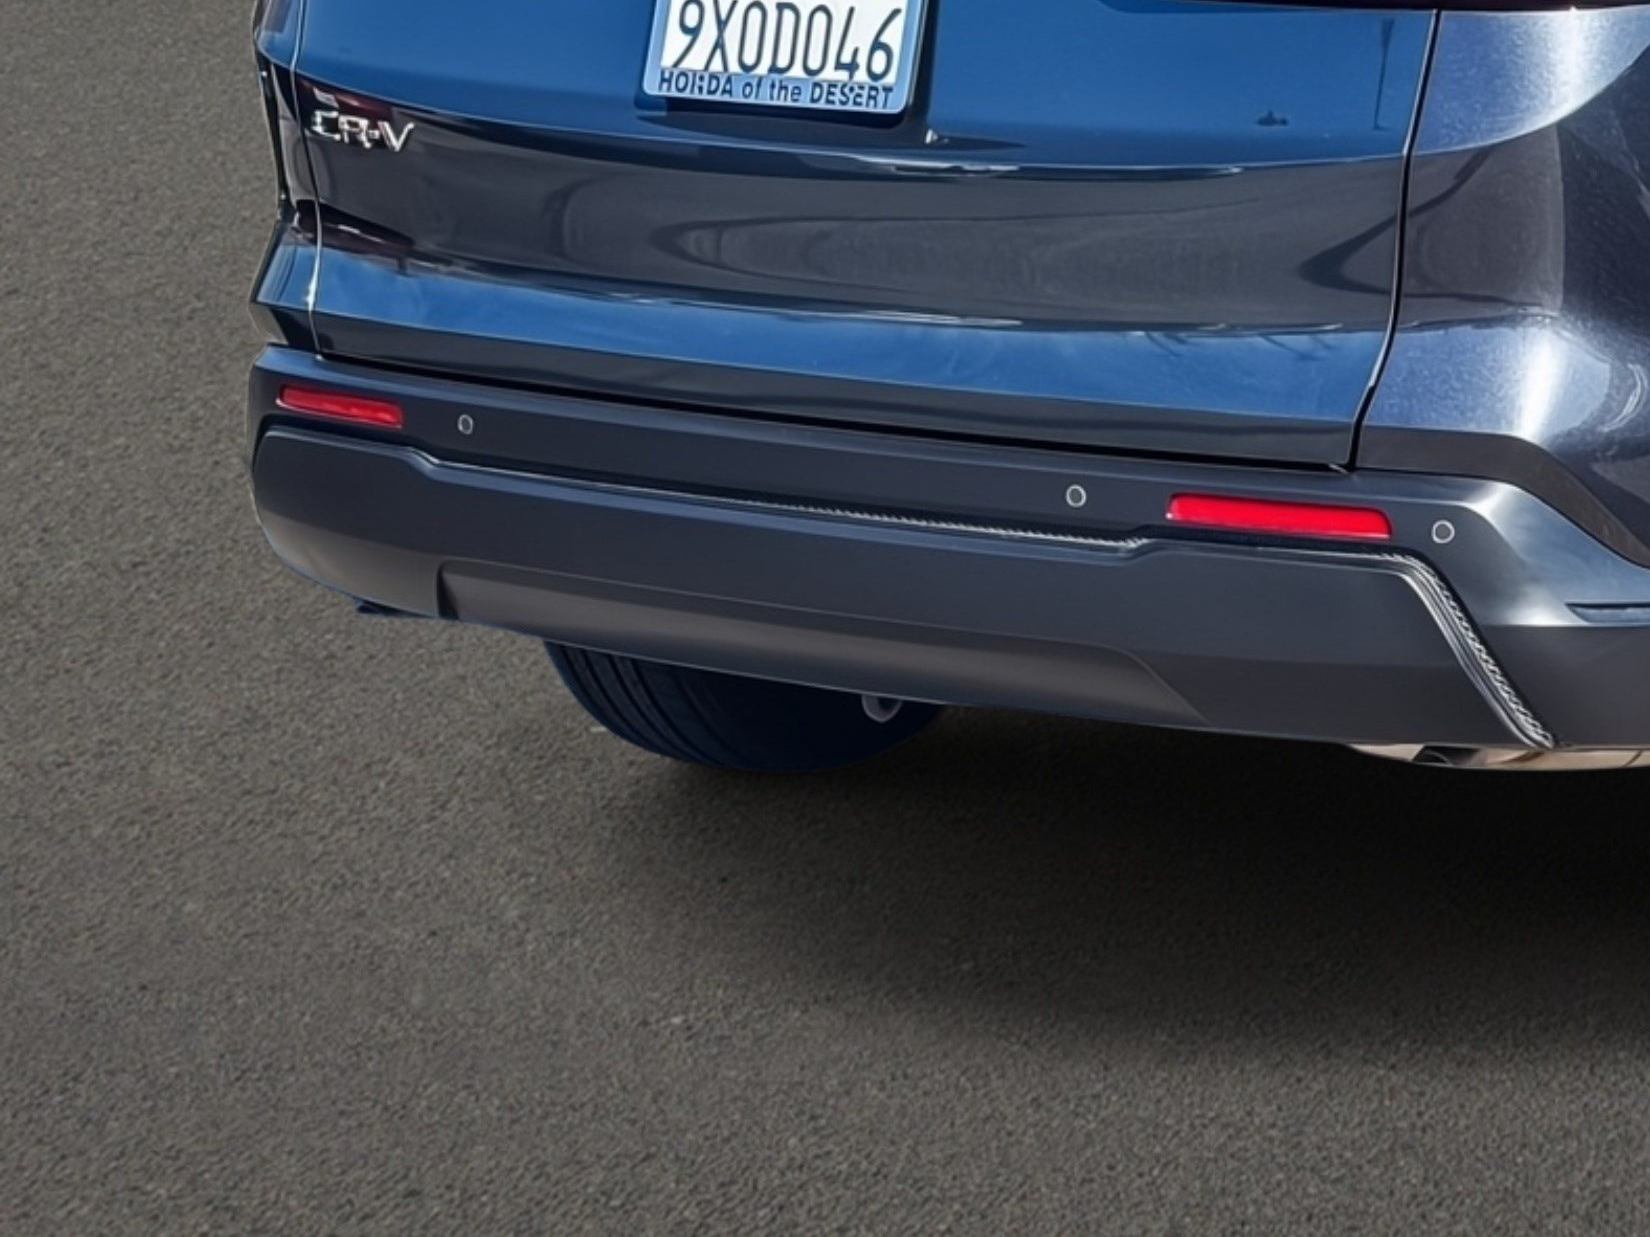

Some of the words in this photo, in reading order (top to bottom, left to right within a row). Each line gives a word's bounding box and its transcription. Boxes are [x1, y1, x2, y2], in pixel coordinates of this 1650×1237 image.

[658, 69, 734, 98] HONDA
[741, 77, 763, 100] of
[769, 79, 802, 103] the
[809, 81, 894, 110] DESERT
[311, 110, 415, 152] CR-V
